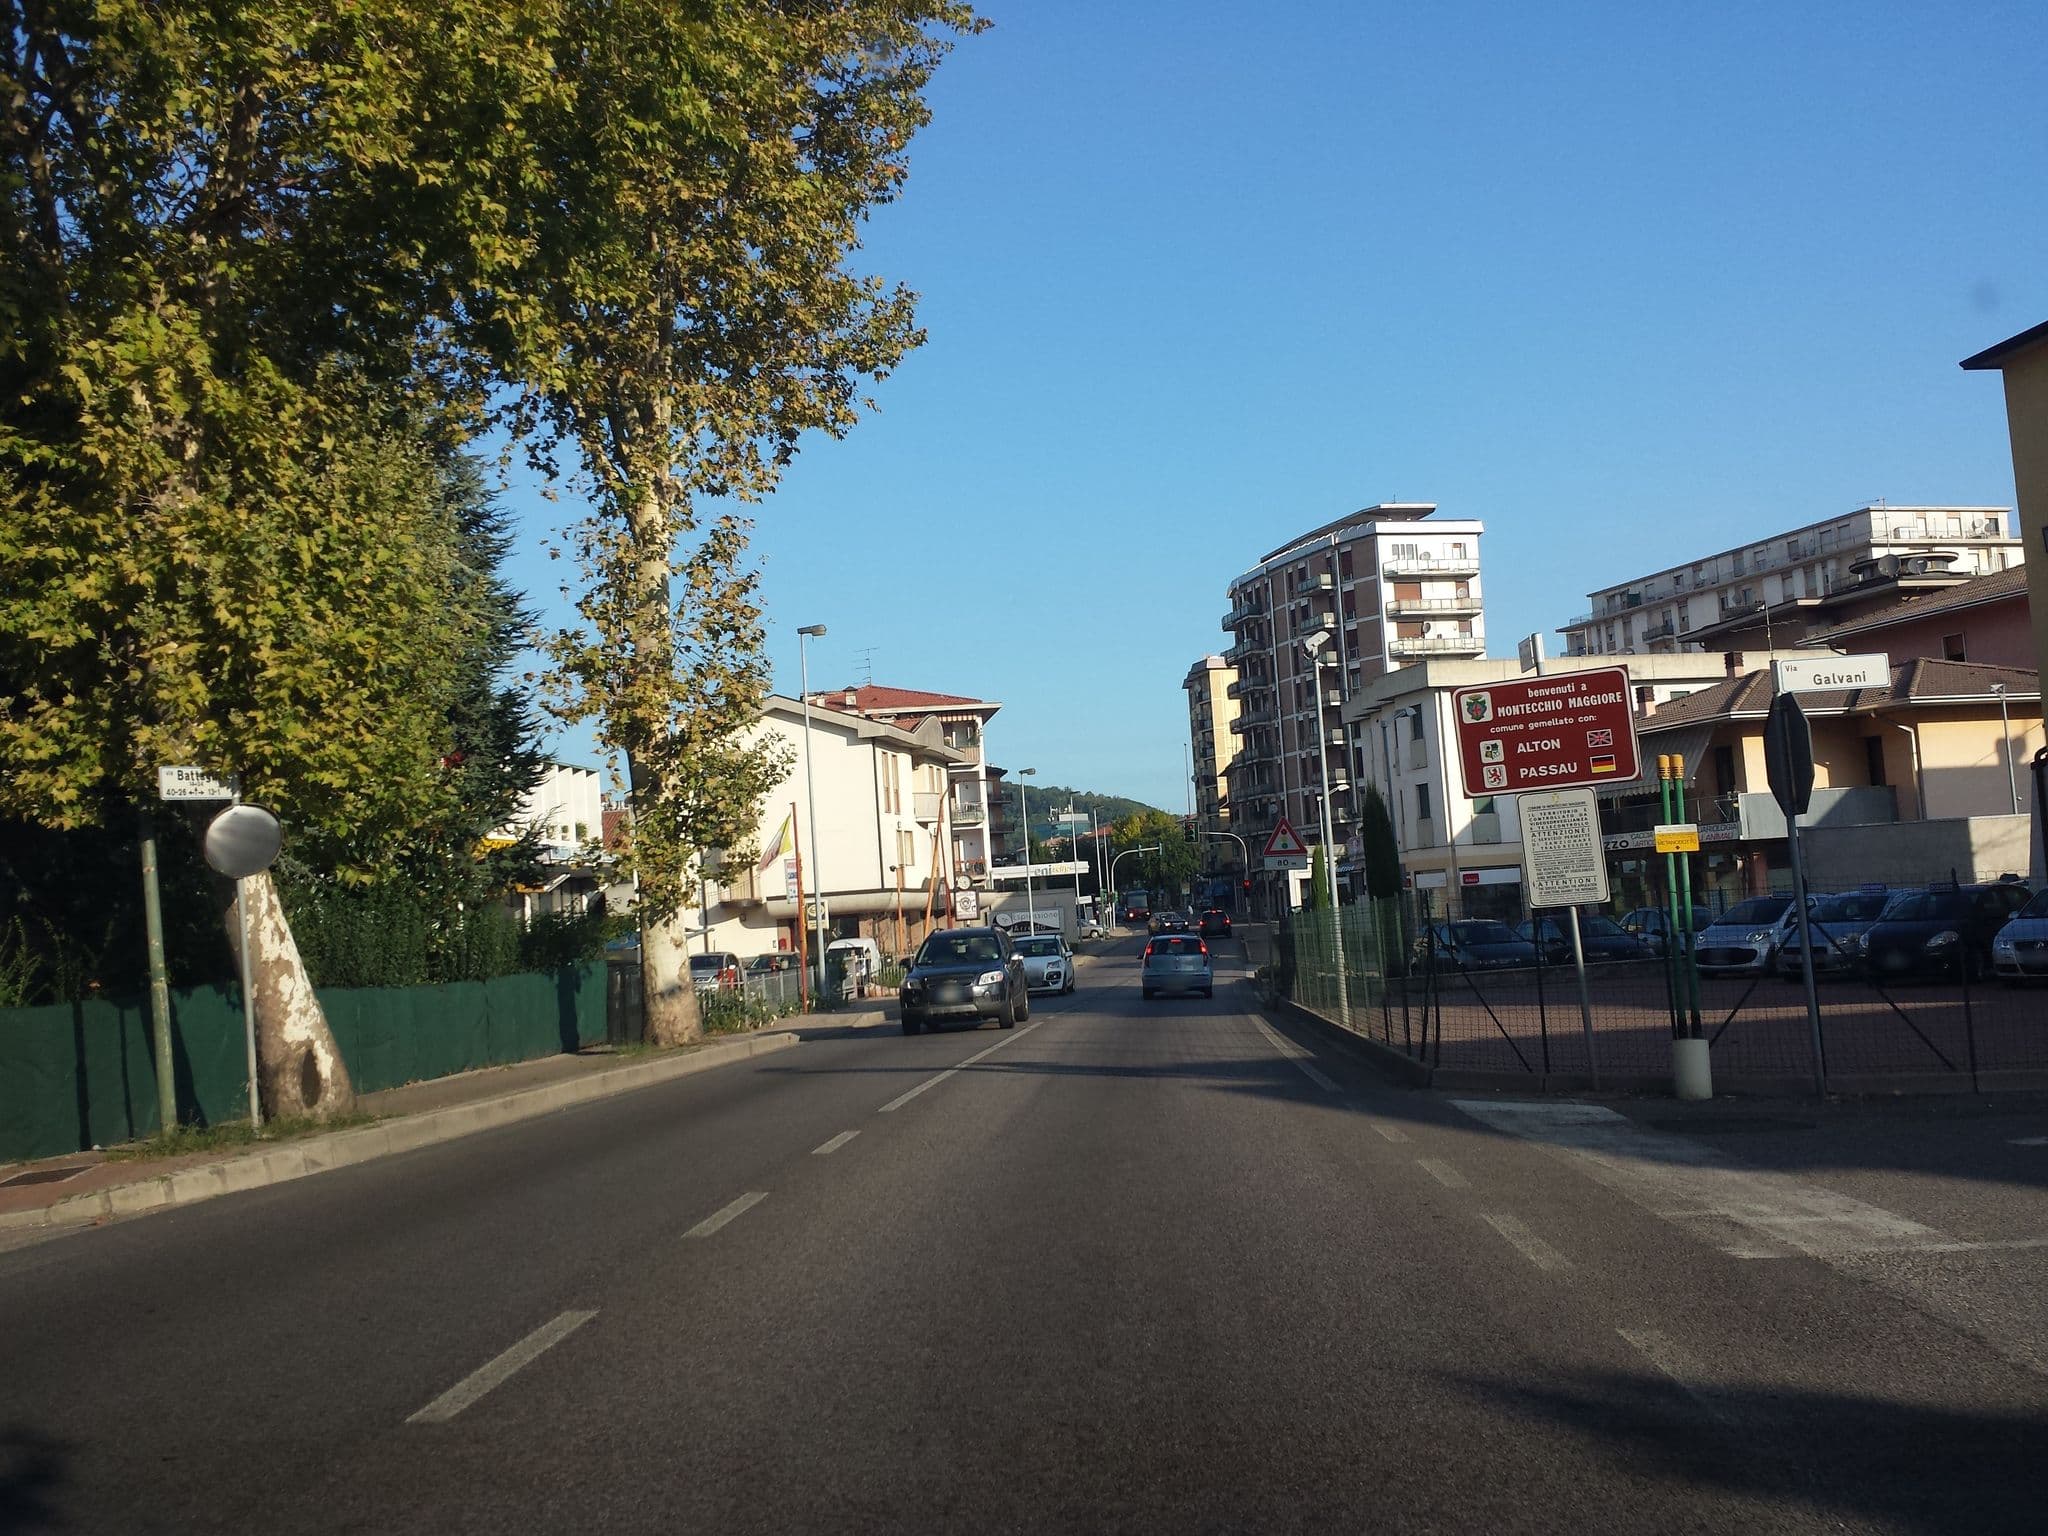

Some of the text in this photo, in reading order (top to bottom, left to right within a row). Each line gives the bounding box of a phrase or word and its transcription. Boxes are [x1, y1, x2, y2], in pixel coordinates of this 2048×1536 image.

[1813, 671, 1866, 685] Galvani
[1528, 683, 1587, 698] benvenuti a
[1498, 692, 1623, 717] MONTECCHIO MAGGIORE
[1490, 715, 1597, 734] comune gemellato con:
[1517, 739, 1561, 753] ALTON
[1520, 762, 1578, 778] PASSAU
